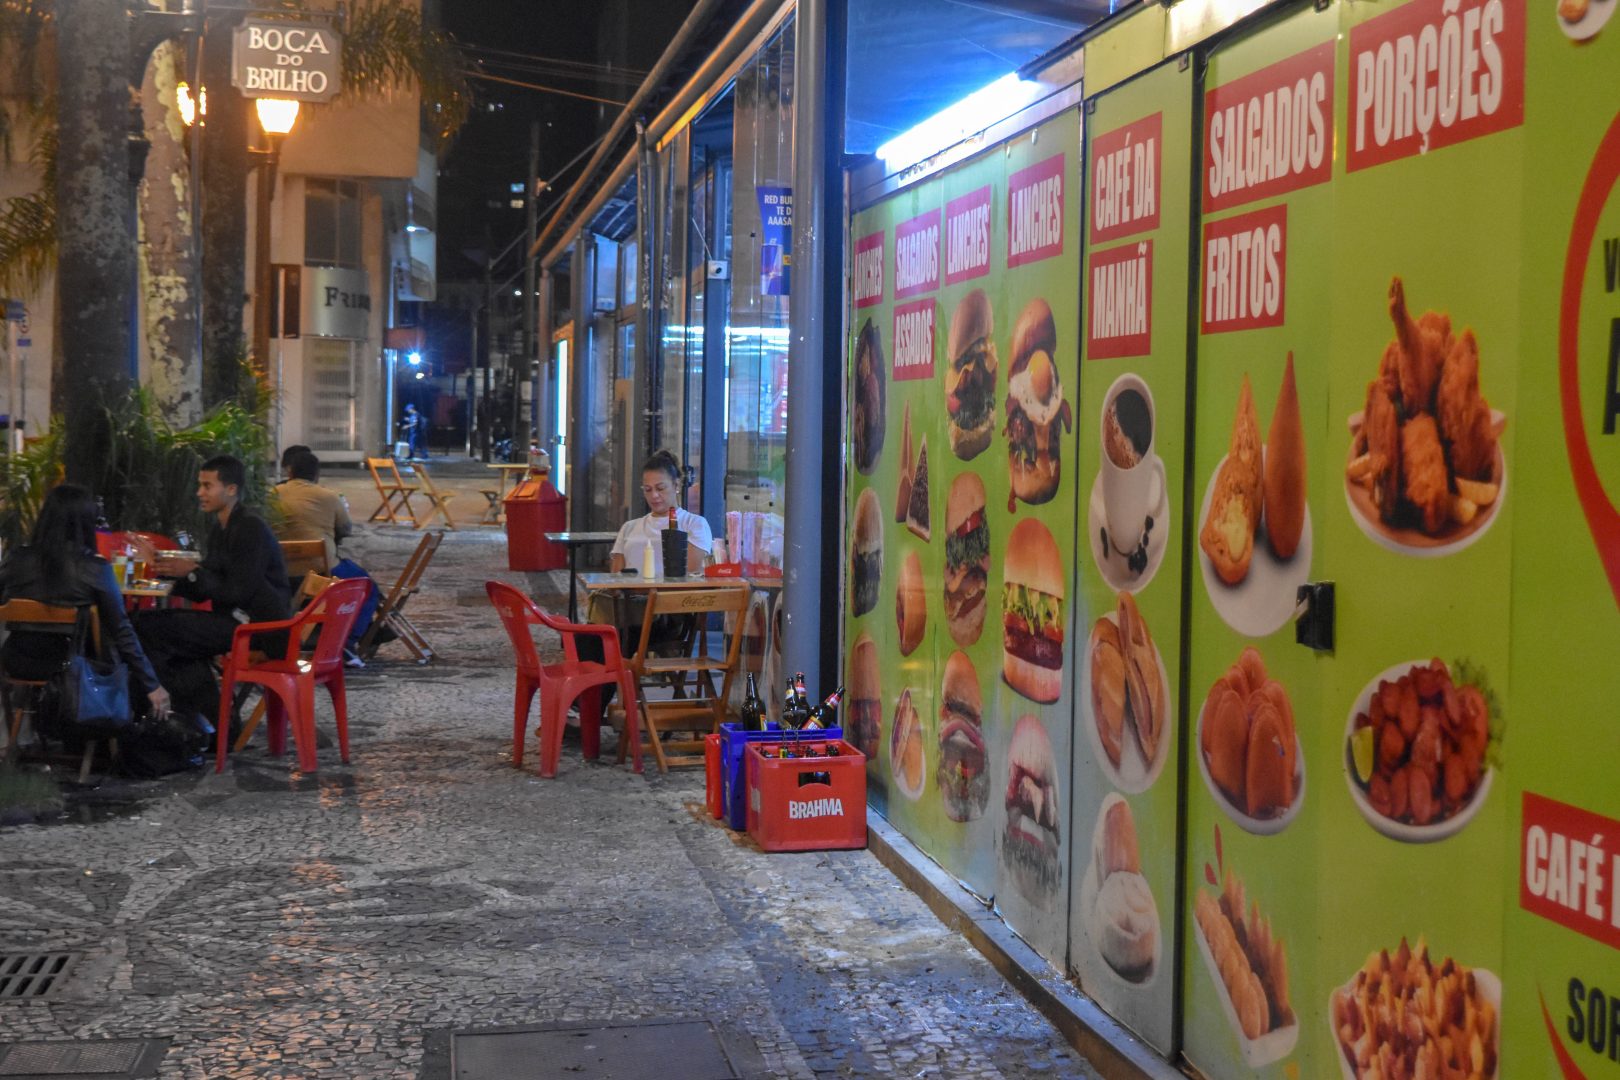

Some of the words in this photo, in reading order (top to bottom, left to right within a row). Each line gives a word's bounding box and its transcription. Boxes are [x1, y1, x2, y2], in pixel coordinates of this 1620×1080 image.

[248, 27, 330, 54] BOCA
[276, 53, 304, 66] DO
[246, 66, 328, 93] BRILHO
[1355, 0, 1503, 155] PORÇÕES
[1209, 71, 1326, 198] SALGADOS
[764, 194, 779, 205] RED
[776, 206, 785, 216] TE
[1010, 174, 1061, 256] LANCHES
[1095, 132, 1132, 231] CAFÉ
[1133, 137, 1155, 221] DA
[854, 245, 883, 300] LANCHES
[896, 224, 939, 291] SALGADOS
[947, 203, 990, 275] LANCHES
[1092, 241, 1147, 339] MANHÃ
[1205, 223, 1281, 323] FRITOS
[894, 308, 933, 367] ASSADOS
[789, 798, 844, 819] BRAHMA
[1526, 825, 1604, 921] CAFÉ
